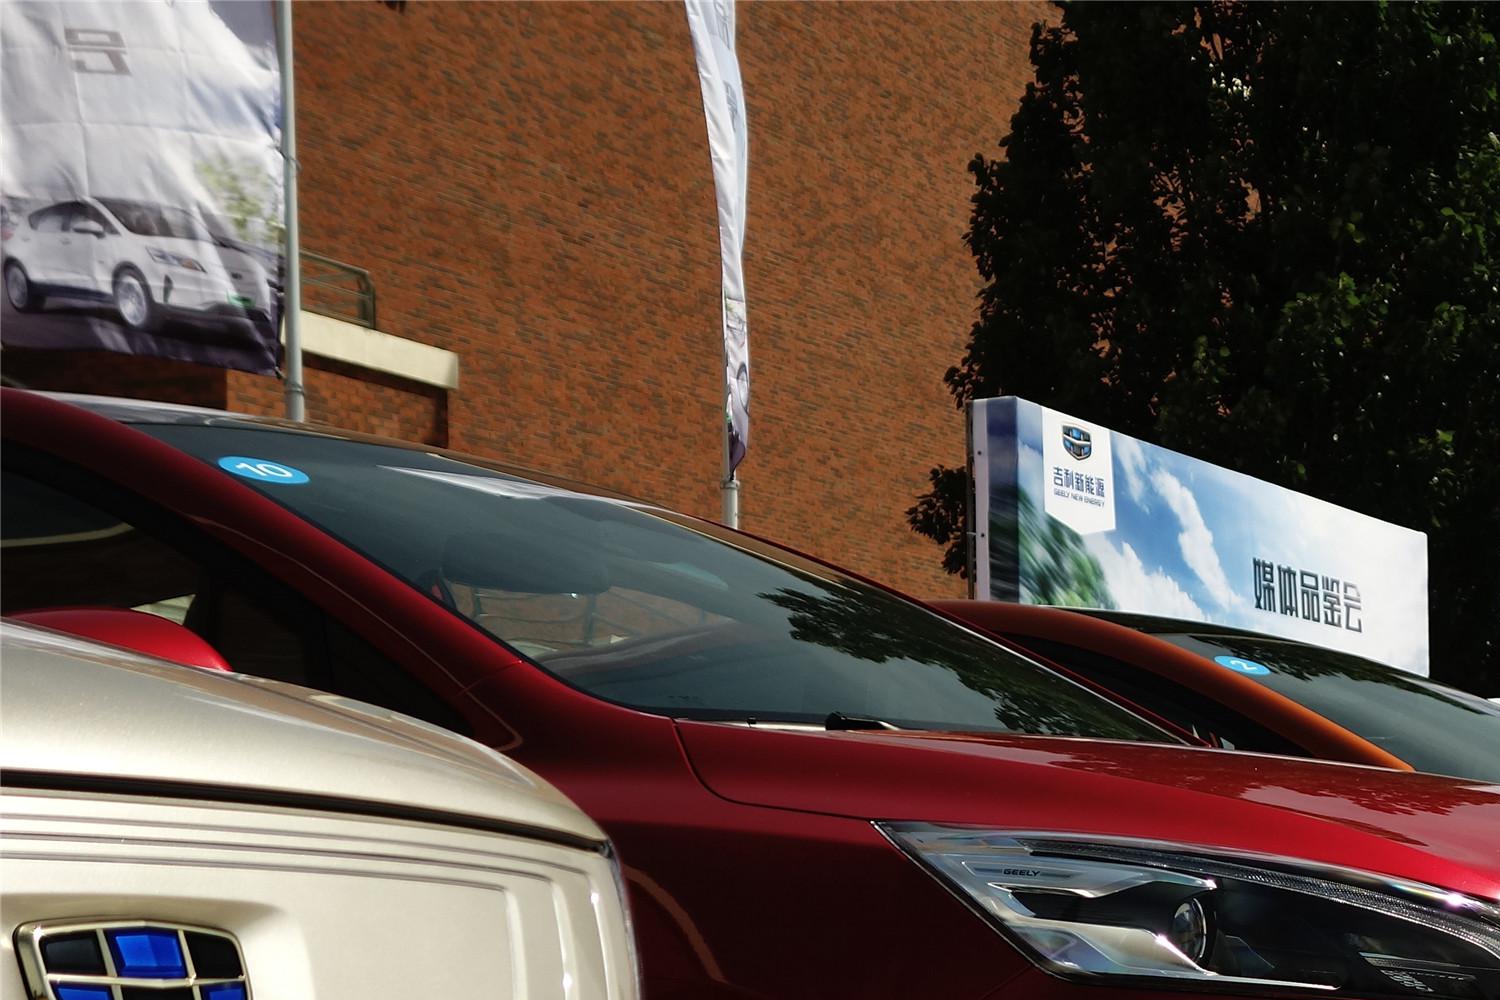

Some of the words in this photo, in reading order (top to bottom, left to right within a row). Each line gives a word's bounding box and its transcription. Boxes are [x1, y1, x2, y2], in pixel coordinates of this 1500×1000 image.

[235, 462, 294, 478] 10
[1053, 466, 1105, 498] 吉利新能源
[1252, 556, 1363, 634] 媒体品鉴会
[1230, 660, 1258, 671] 2
[1003, 867, 1041, 877] GEELY
